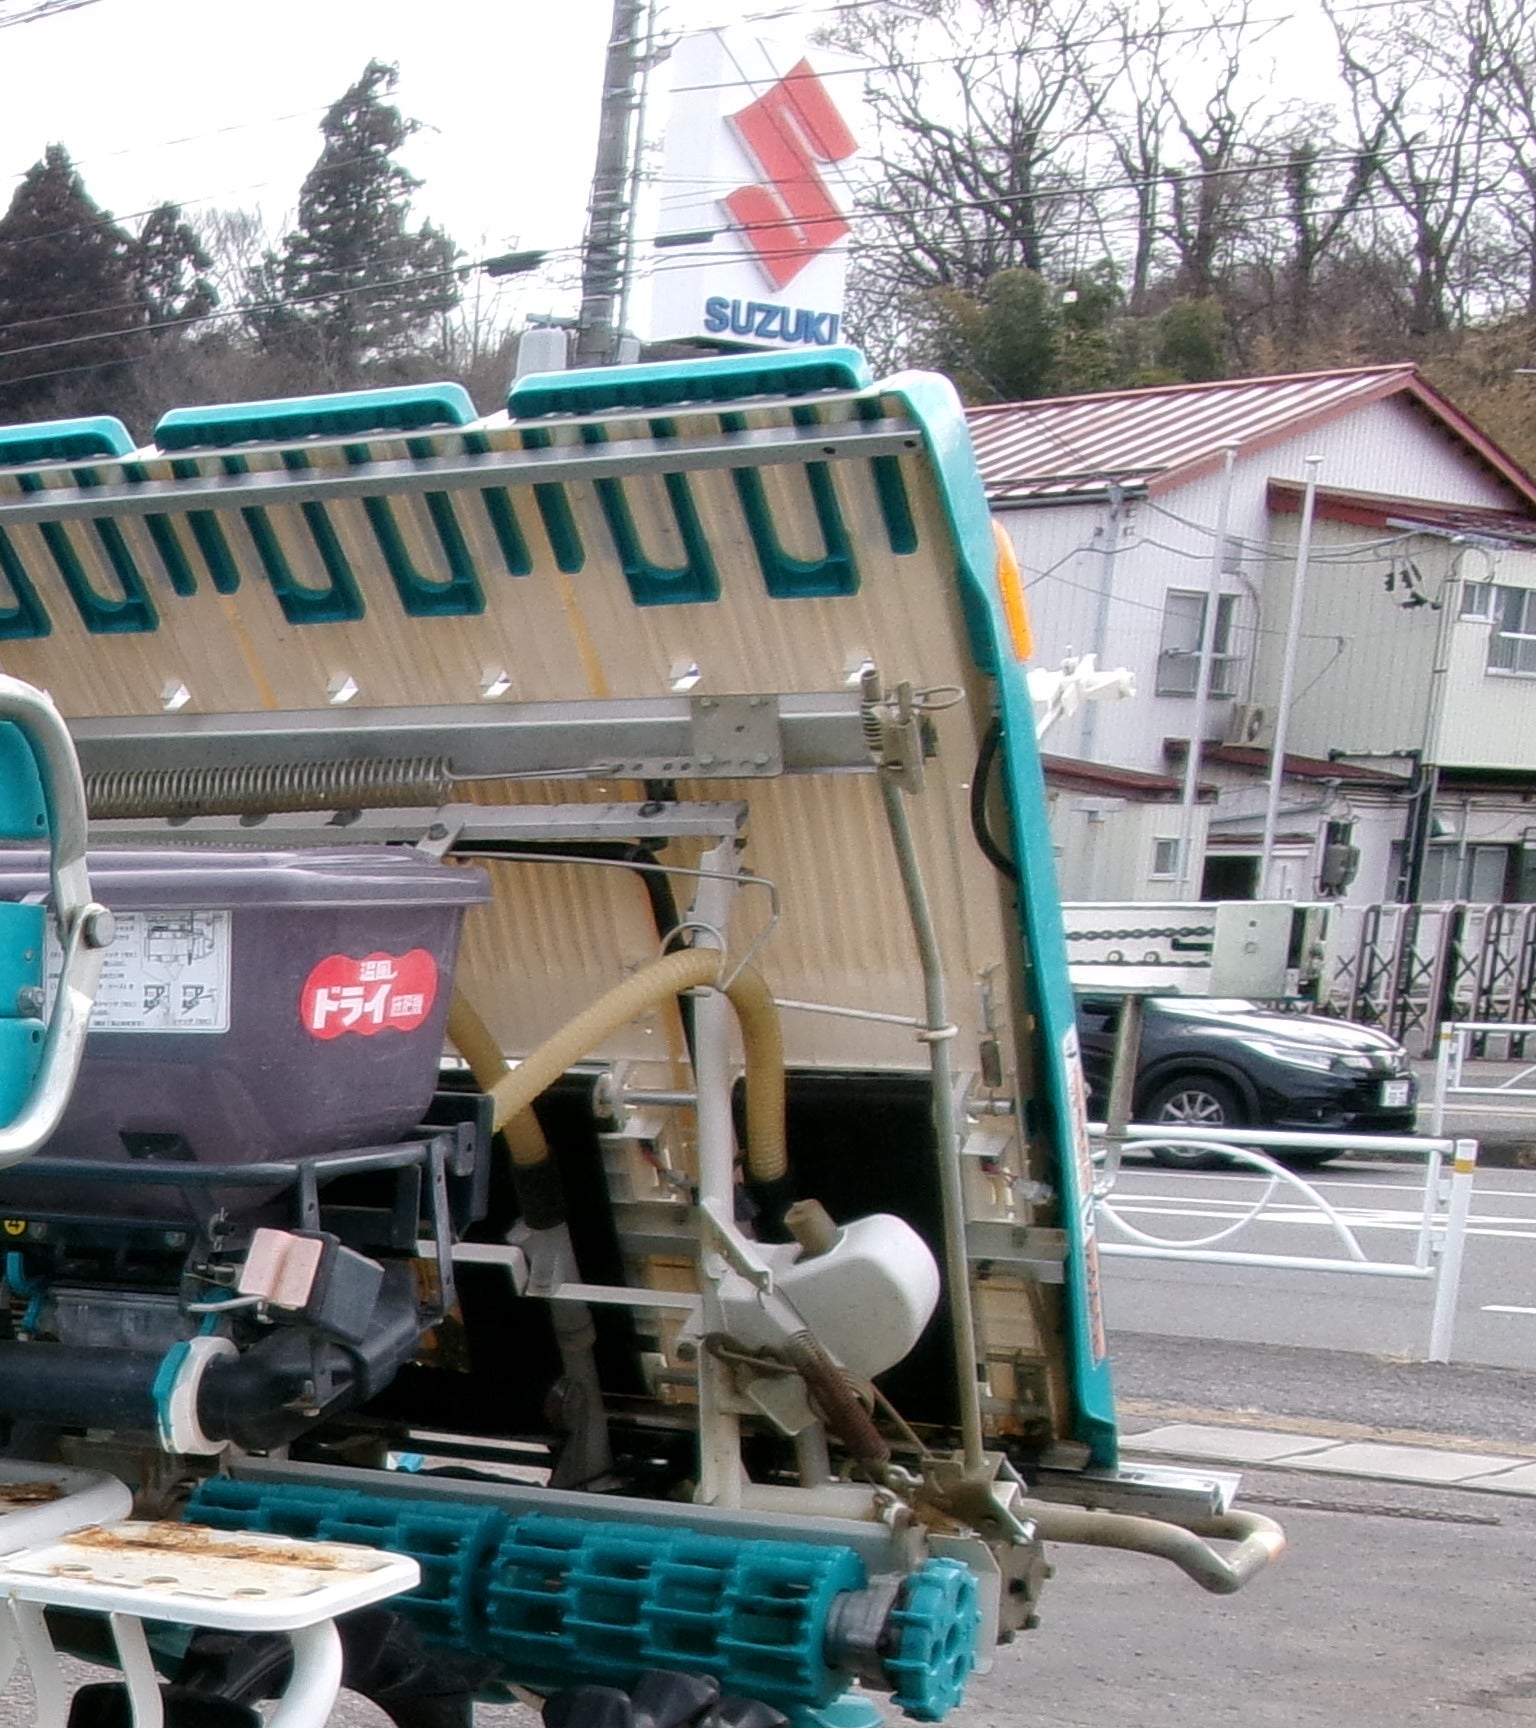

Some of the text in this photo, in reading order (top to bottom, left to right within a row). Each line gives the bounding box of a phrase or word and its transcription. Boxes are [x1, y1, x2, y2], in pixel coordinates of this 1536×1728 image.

[704, 297, 841, 345] SUZUKI
[312, 984, 392, 1030] ドライ
